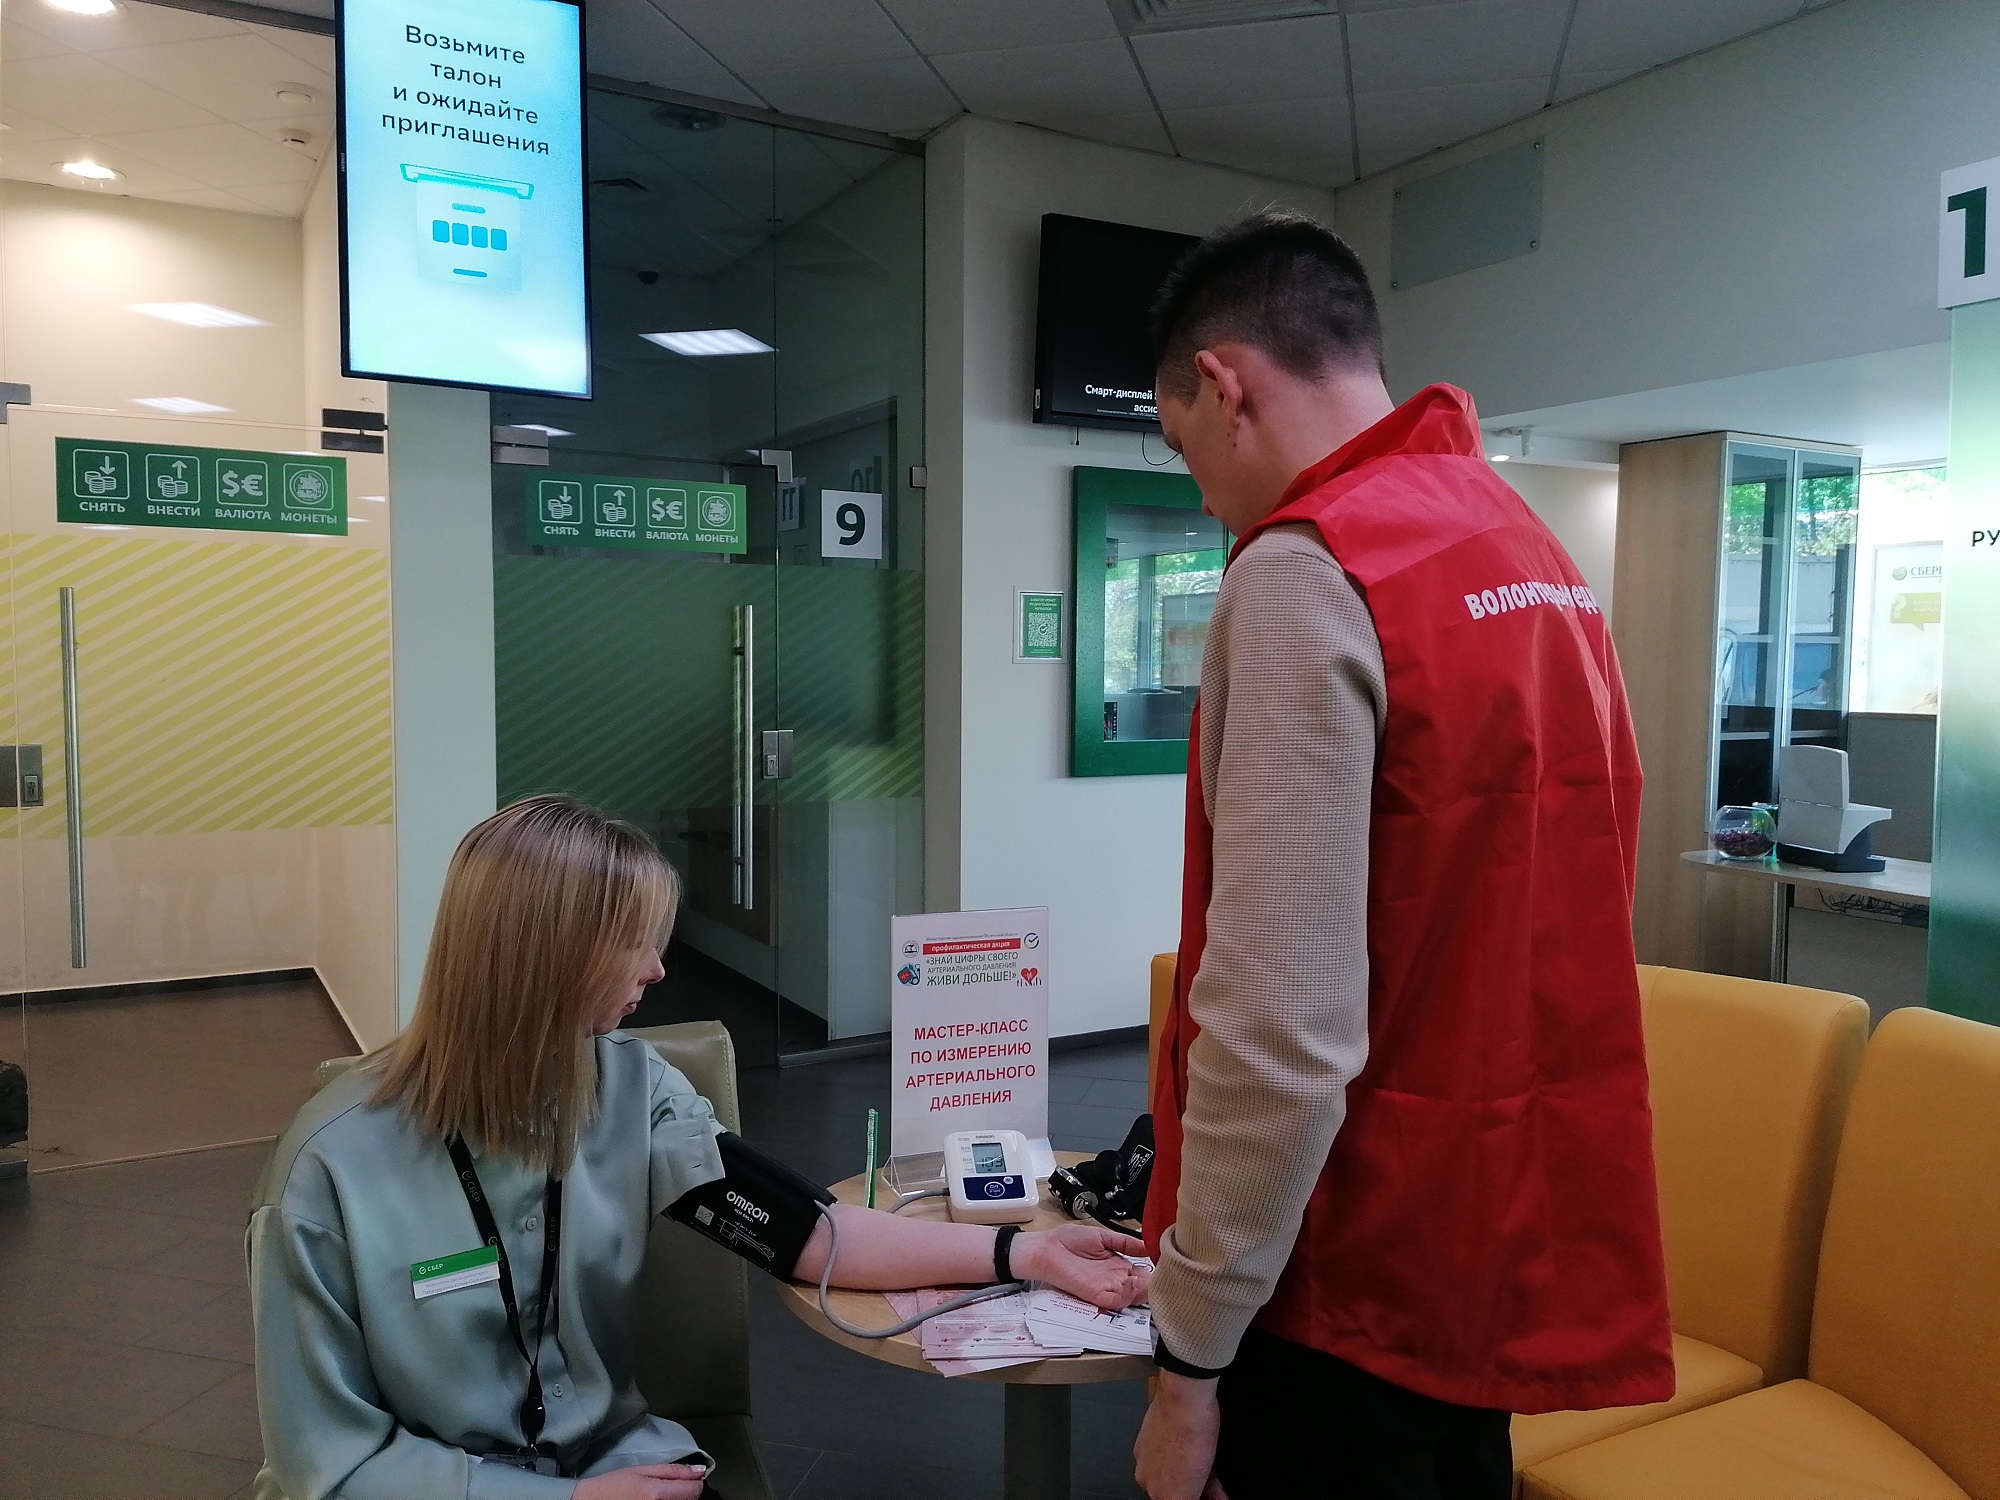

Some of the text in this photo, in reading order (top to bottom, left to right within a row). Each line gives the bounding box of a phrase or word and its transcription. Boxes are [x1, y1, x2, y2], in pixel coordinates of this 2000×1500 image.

[405, 24, 526, 65] Возьмите
[430, 61, 502, 89] талон
[392, 84, 539, 125] и ожидайте
[381, 112, 551, 156] приглашения
[1947, 186, 1987, 279] 1
[1084, 383, 1153, 400] Смарт-дисплей
[78, 500, 338, 525] СНЯТЬ ВНЕСТИ ВАЛЮТА МОНЕТЫ
[836, 502, 866, 546] 9
[543, 525, 739, 545] СНЯТЬ ВНЕСТИ ВАЛЮТА МОНЕТЫ
[926, 951, 1019, 966] «ЗНАЙ ЦИФРЫ СВОЕГО
[931, 941, 1010, 953] профилактическая акция
[926, 970, 1017, 987] ЖИВИ ДОЛЬШЕ!»
[927, 964, 980, 974] АРТЕРИАЛЬНОГО
[914, 1019, 1029, 1041] МАСТЕР-КЛАСС
[910, 1041, 1032, 1065] ПО ИЗМЕРЕНИЮ
[905, 1064, 1036, 1089] АРТЕРИАЛЬНОГО
[929, 1089, 1012, 1112] ДАВЛЕНИЯ
[726, 1190, 770, 1225] OMRON
[426, 1263, 444, 1272] СБЕР
